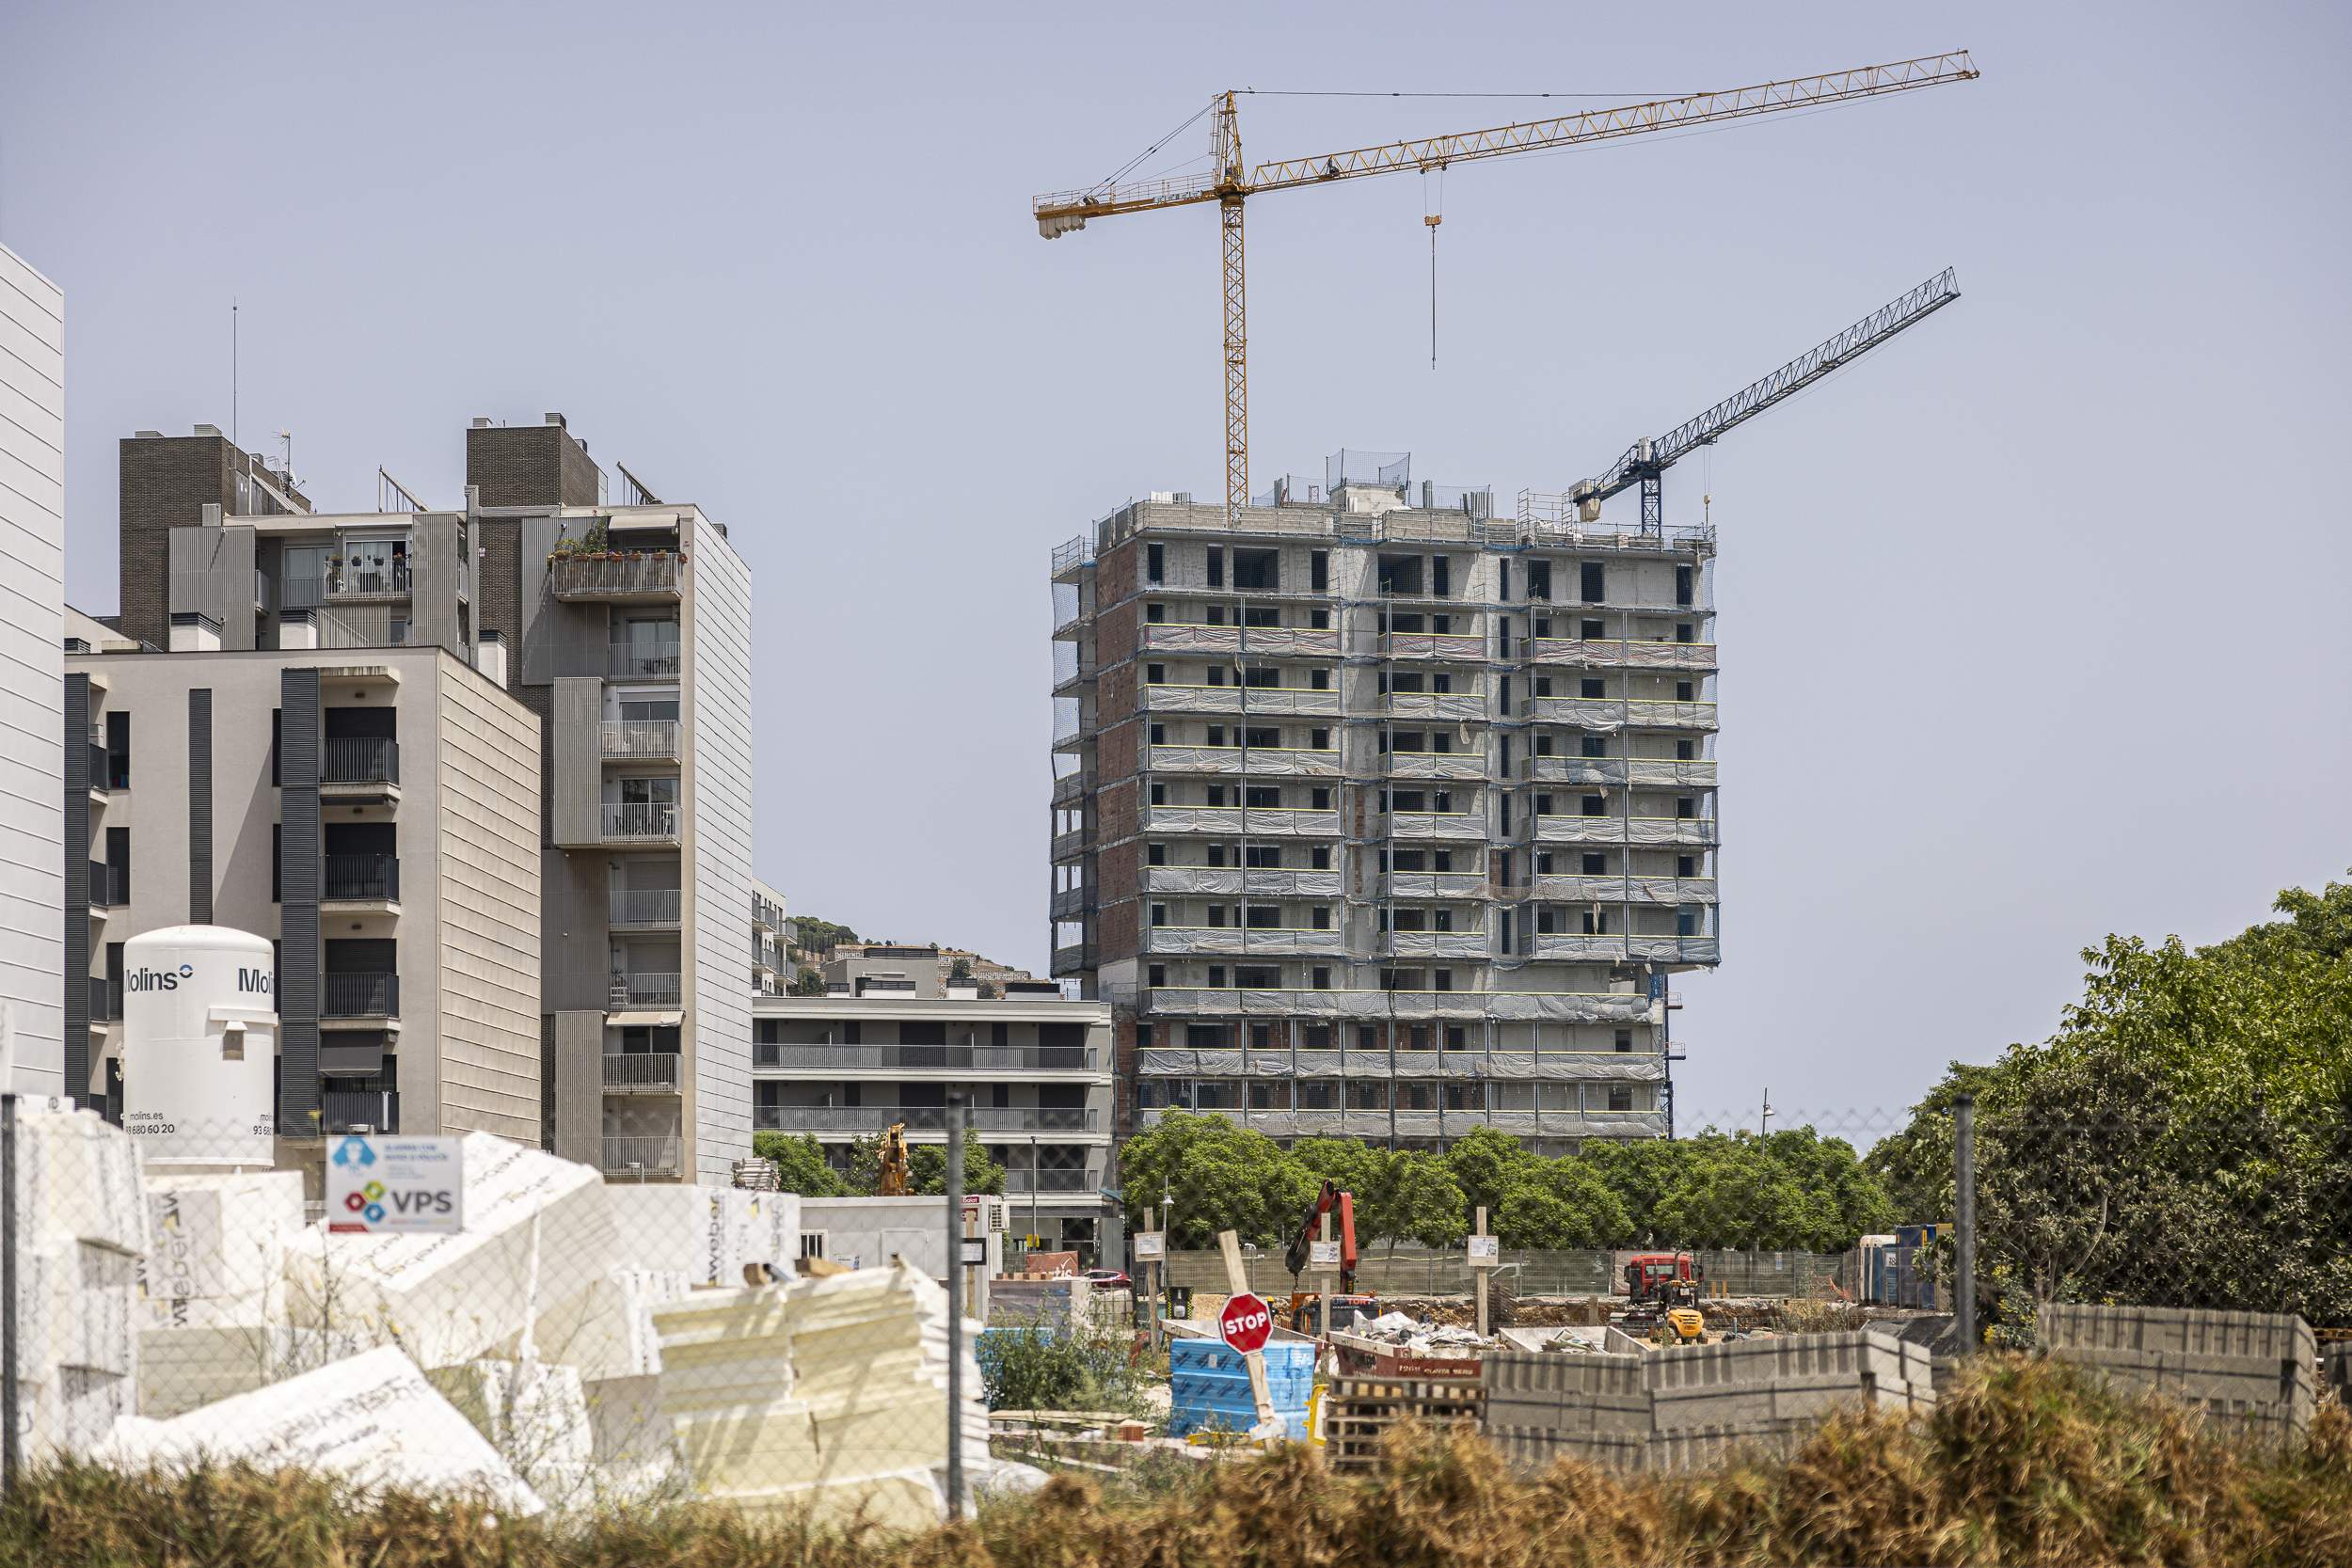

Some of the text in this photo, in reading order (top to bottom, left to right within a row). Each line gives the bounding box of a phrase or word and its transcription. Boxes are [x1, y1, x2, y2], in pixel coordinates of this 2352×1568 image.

[130, 1111, 164, 1120] molins.es
[133, 1125, 146, 1134] 680
[148, 1124, 160, 1134] 60
[161, 1123, 175, 1133] 20
[253, 1125, 262, 1135] 93
[390, 1190, 453, 1214] VPS
[1225, 1311, 1267, 1335] STOP
